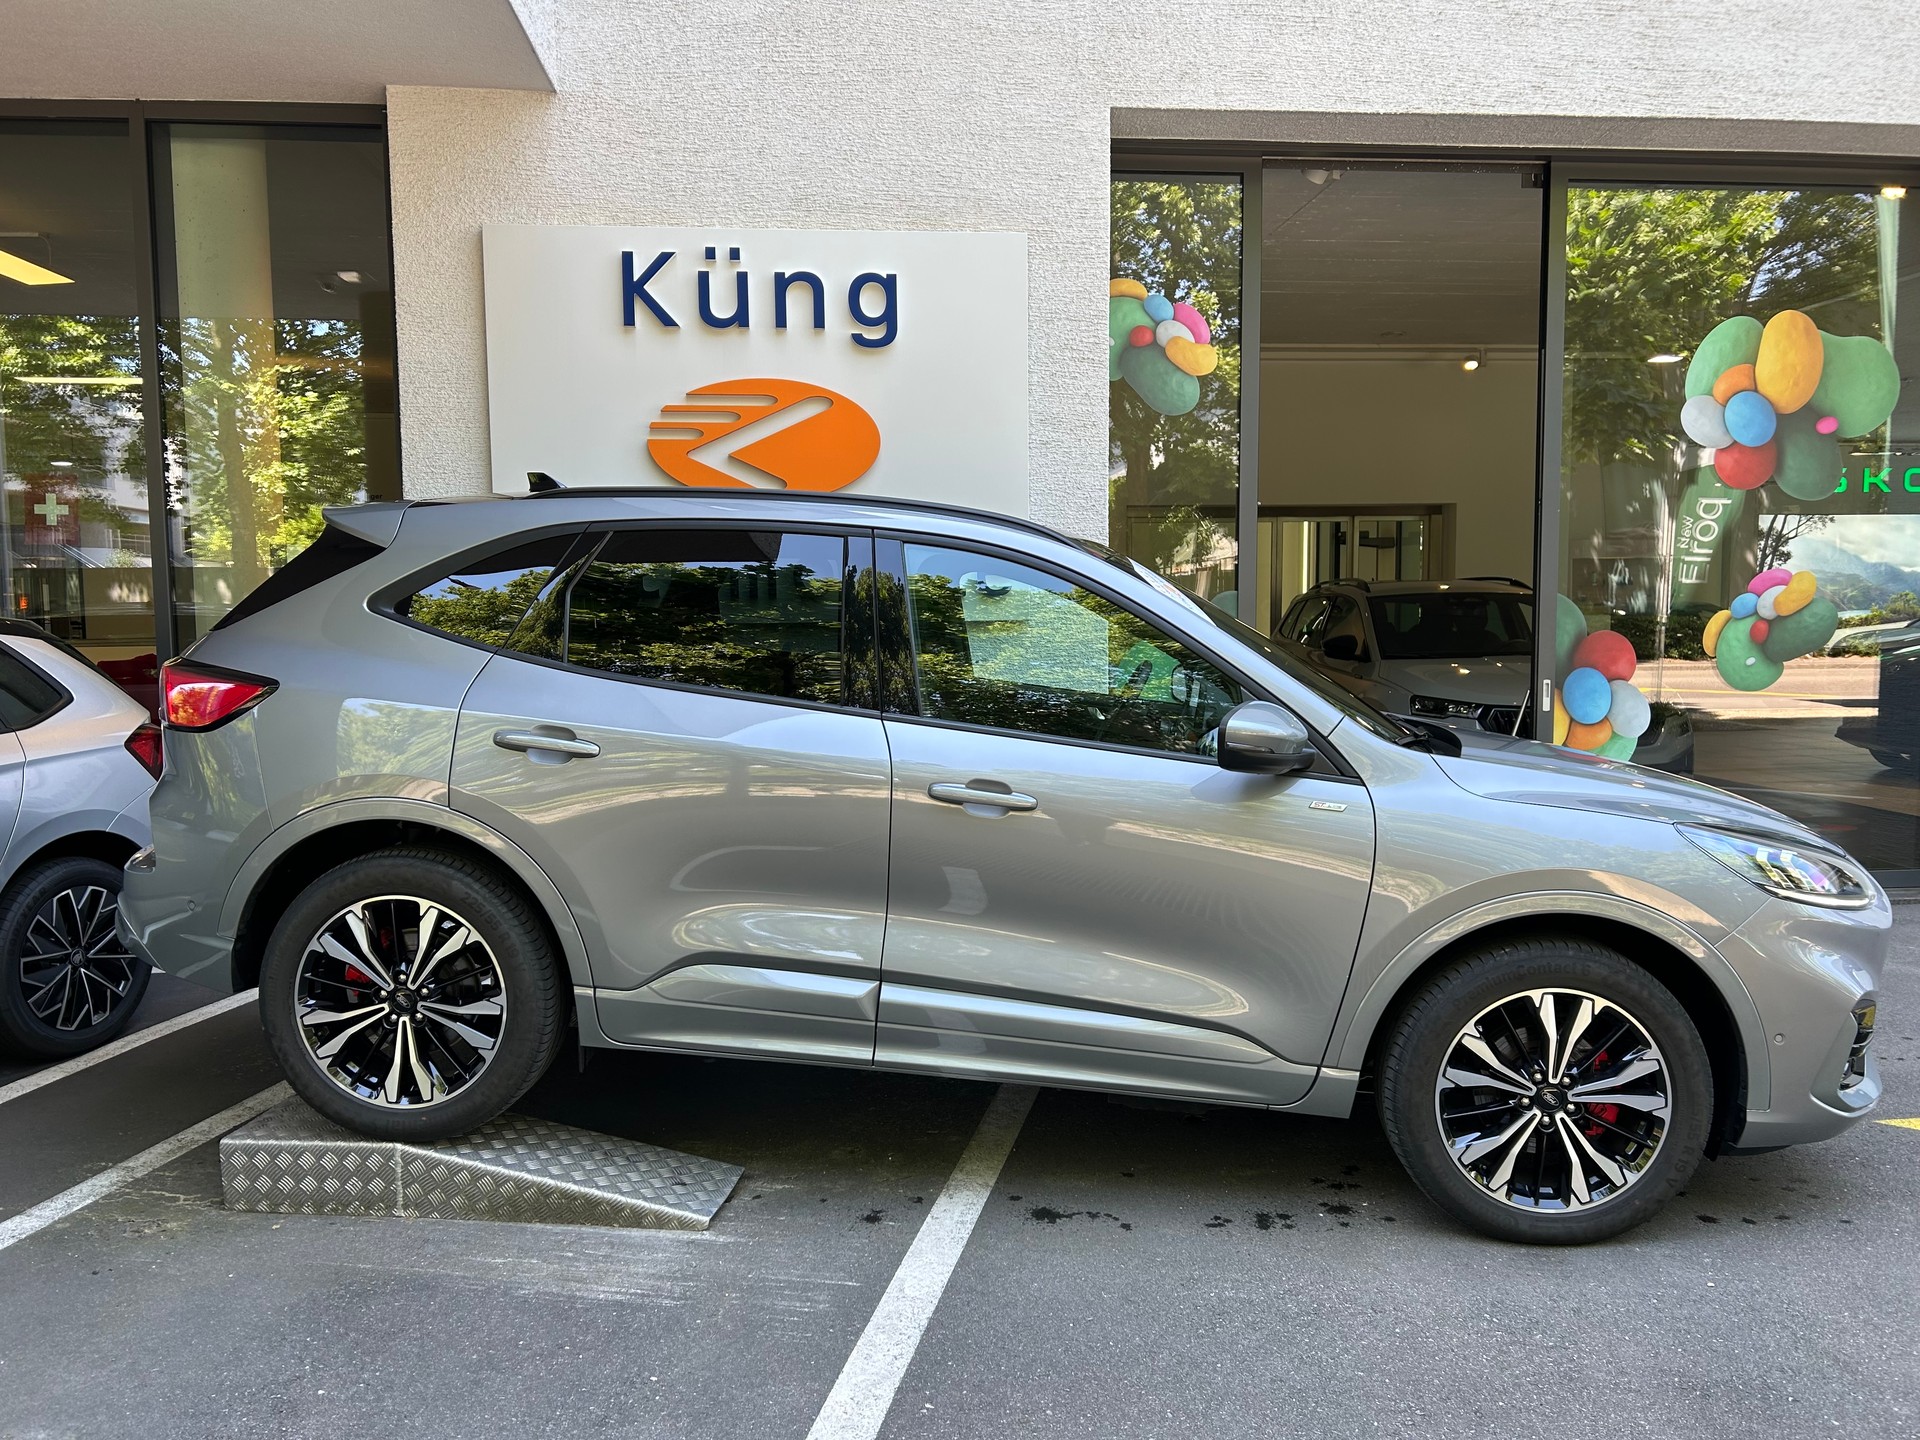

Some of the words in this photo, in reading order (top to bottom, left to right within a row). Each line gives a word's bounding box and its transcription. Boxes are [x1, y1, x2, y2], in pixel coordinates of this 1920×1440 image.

[621, 246, 898, 348] Küng
[1677, 515, 1693, 548] New
[1679, 498, 1732, 583] Elroq
